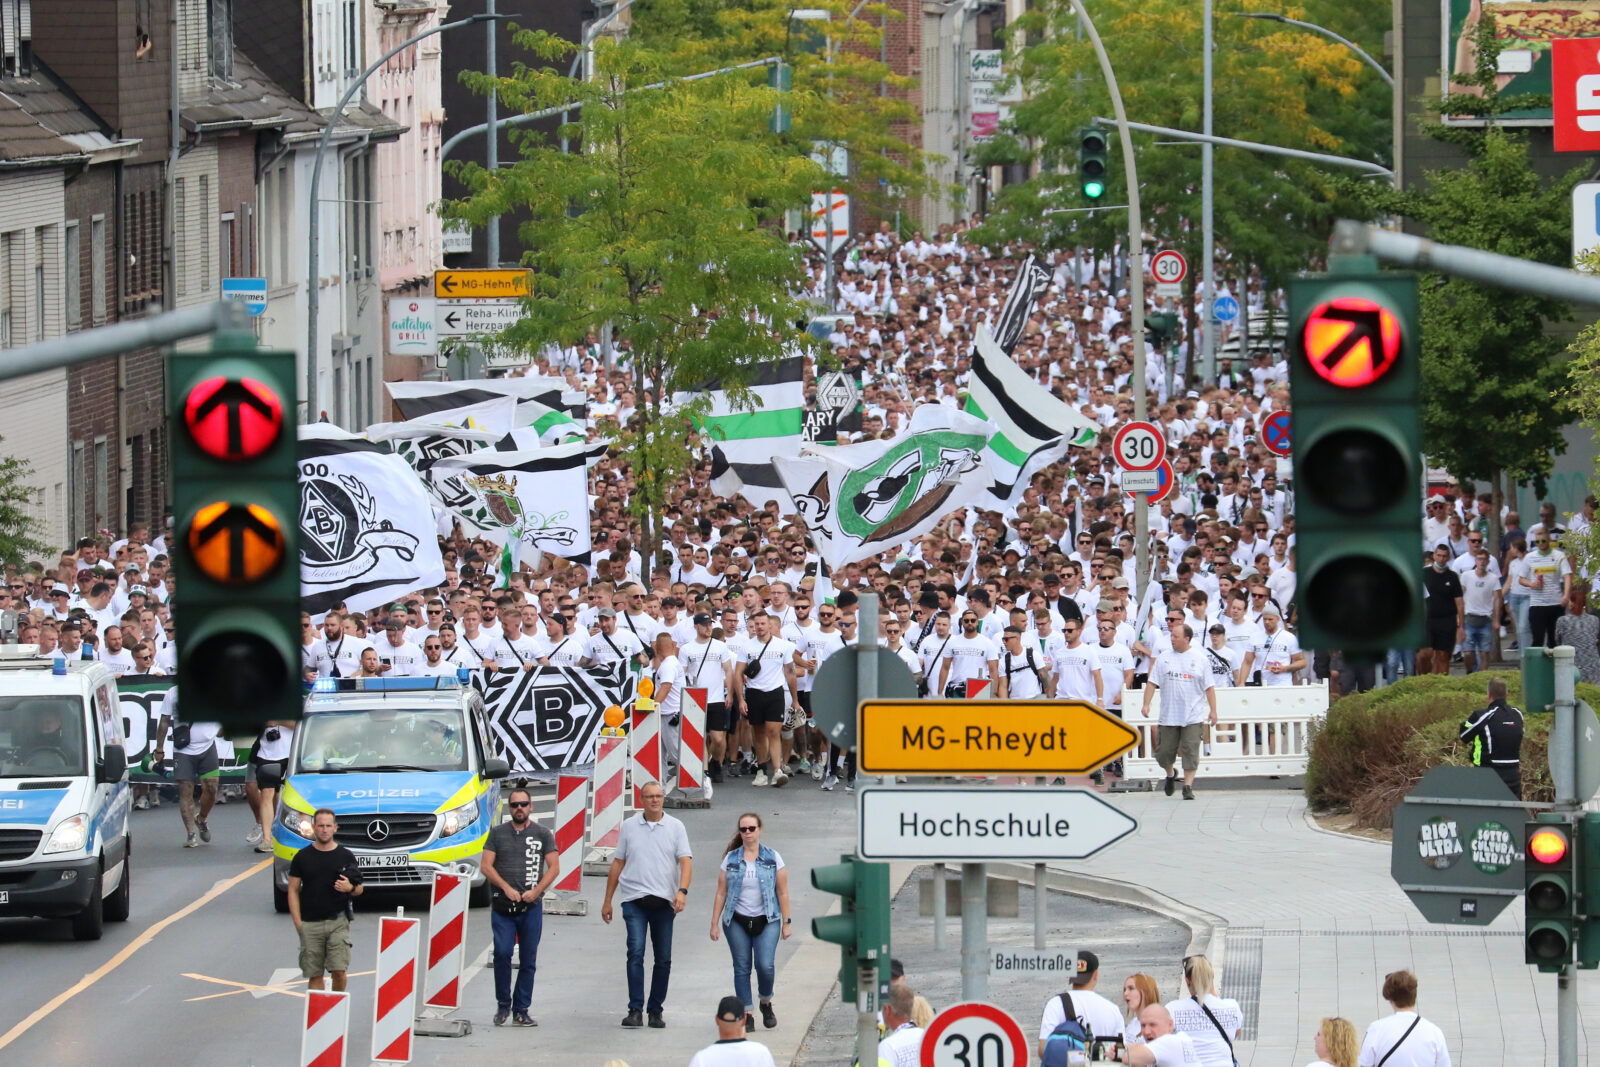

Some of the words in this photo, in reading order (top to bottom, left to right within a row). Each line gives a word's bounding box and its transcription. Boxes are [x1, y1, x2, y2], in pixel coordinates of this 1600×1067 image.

[1159, 260, 1178, 275] 30
[461, 279, 511, 289] MG-Hehn
[465, 308, 526, 318] Reha-Klini
[398, 332, 426, 340] GRILL
[801, 410, 835, 427] ARY
[1124, 436, 1154, 460] 30
[299, 463, 329, 478] 00
[532, 687, 575, 745] B
[901, 725, 1068, 757] MG-Rheydt
[336, 789, 420, 799] POLIZEI
[0, 799, 24, 809] EI
[900, 812, 1070, 838] Hochschule
[1421, 821, 1458, 841] RIOT
[1478, 829, 1510, 843] SOTTO
[1419, 838, 1464, 858] ULTRA
[1471, 839, 1515, 855] CULTURA
[386, 855, 407, 866] 2499
[1473, 851, 1511, 866] ULTRAS
[995, 953, 1072, 971] Bahnstraße
[943, 1032, 1004, 1067] 30
